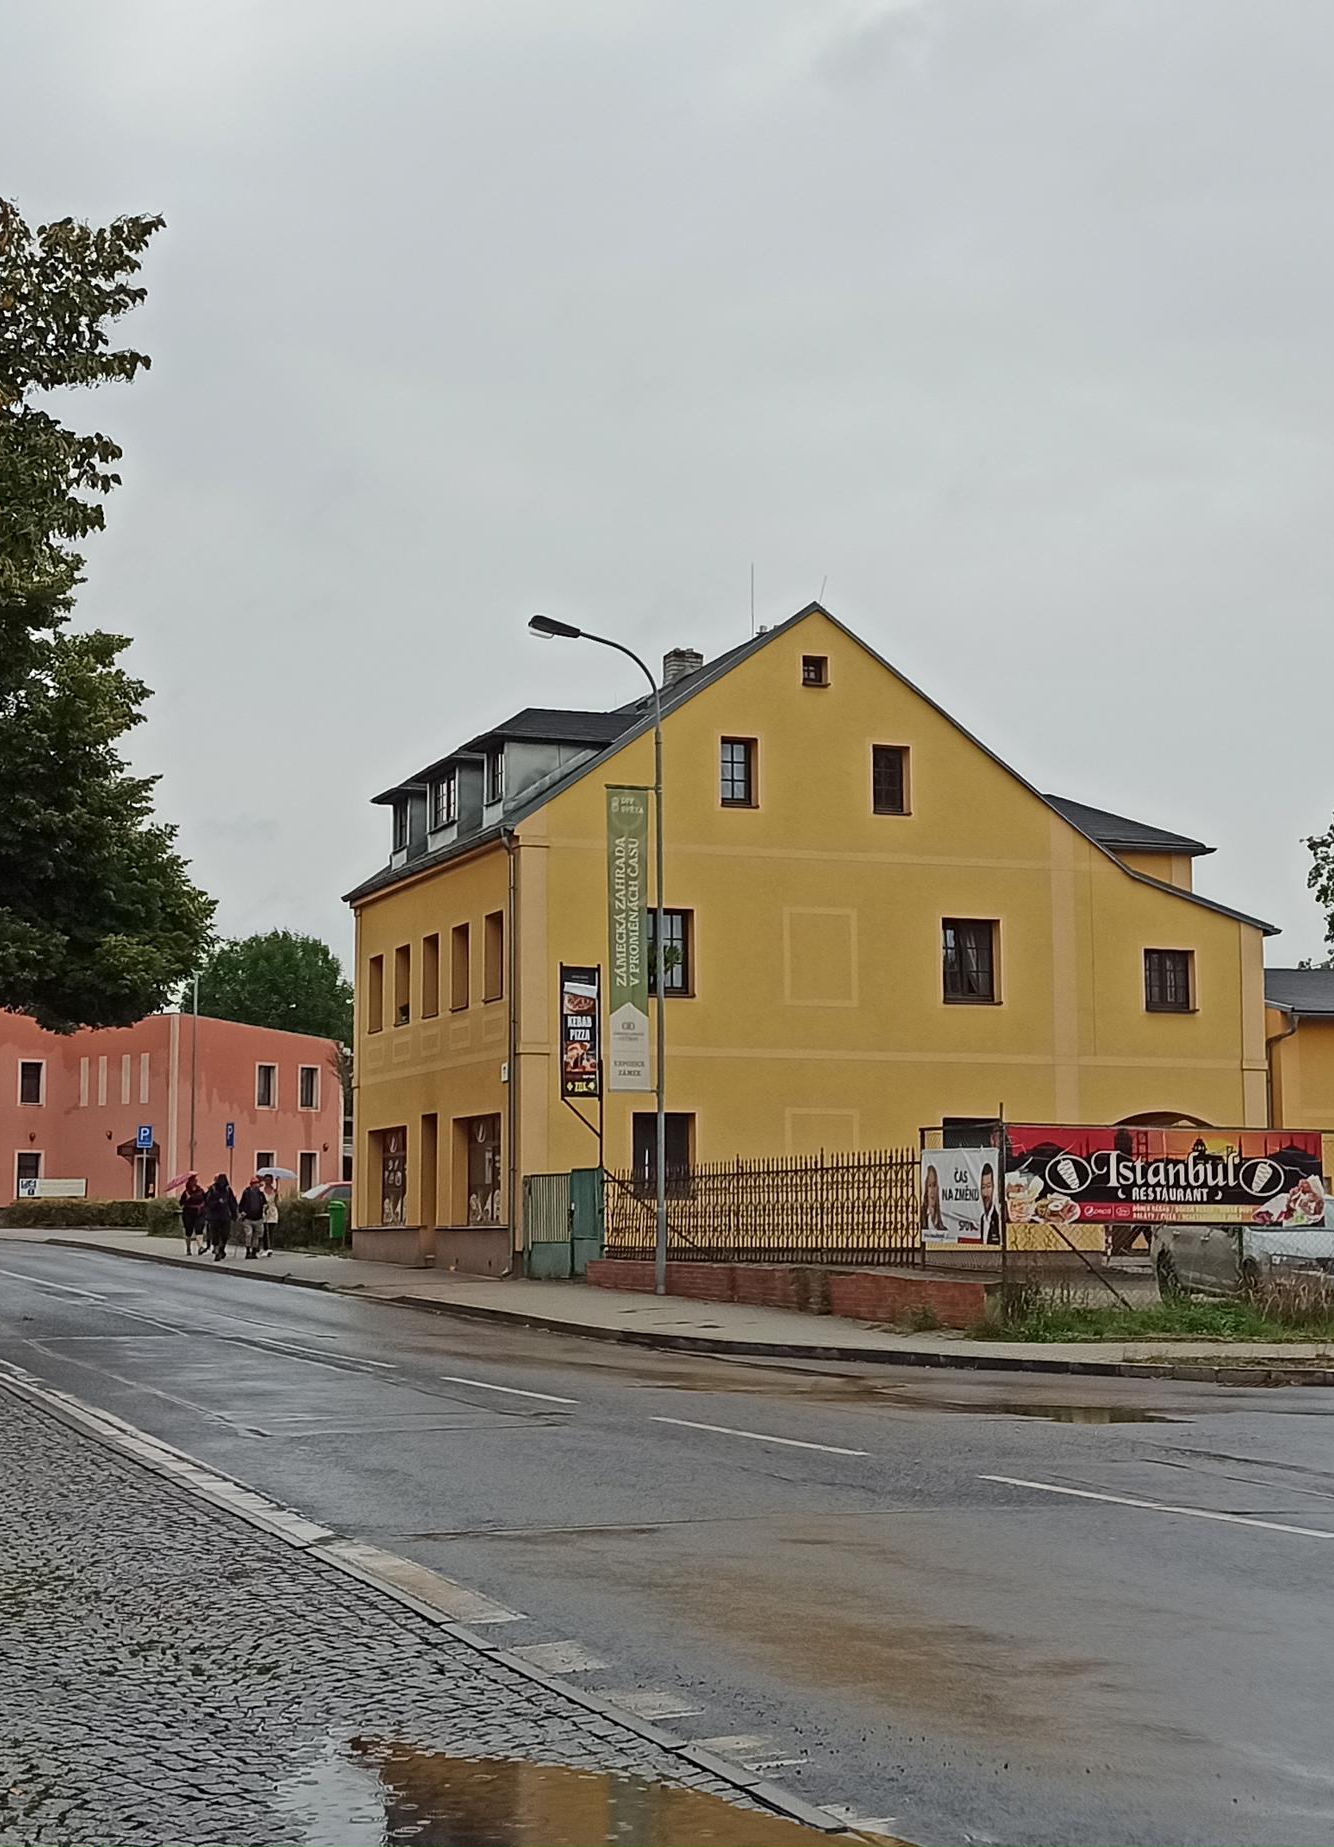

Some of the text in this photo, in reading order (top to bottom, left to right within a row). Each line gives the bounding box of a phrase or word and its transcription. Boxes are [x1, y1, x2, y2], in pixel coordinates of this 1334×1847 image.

[613, 836, 627, 988] ZÁMECKÁ ZAHRADA
[627, 838, 641, 986] V PROMĚNÁCH ČASU
[567, 1016, 592, 1029] KEBAB
[569, 1029, 591, 1041] PIZZA
[140, 1127, 150, 1141] P
[228, 1125, 233, 1140] P
[954, 1167, 969, 1184] ČAS
[1091, 1150, 1238, 1187] Istanbul
[941, 1187, 954, 1201] NA
[1131, 1187, 1209, 1202] RESTAURANT
